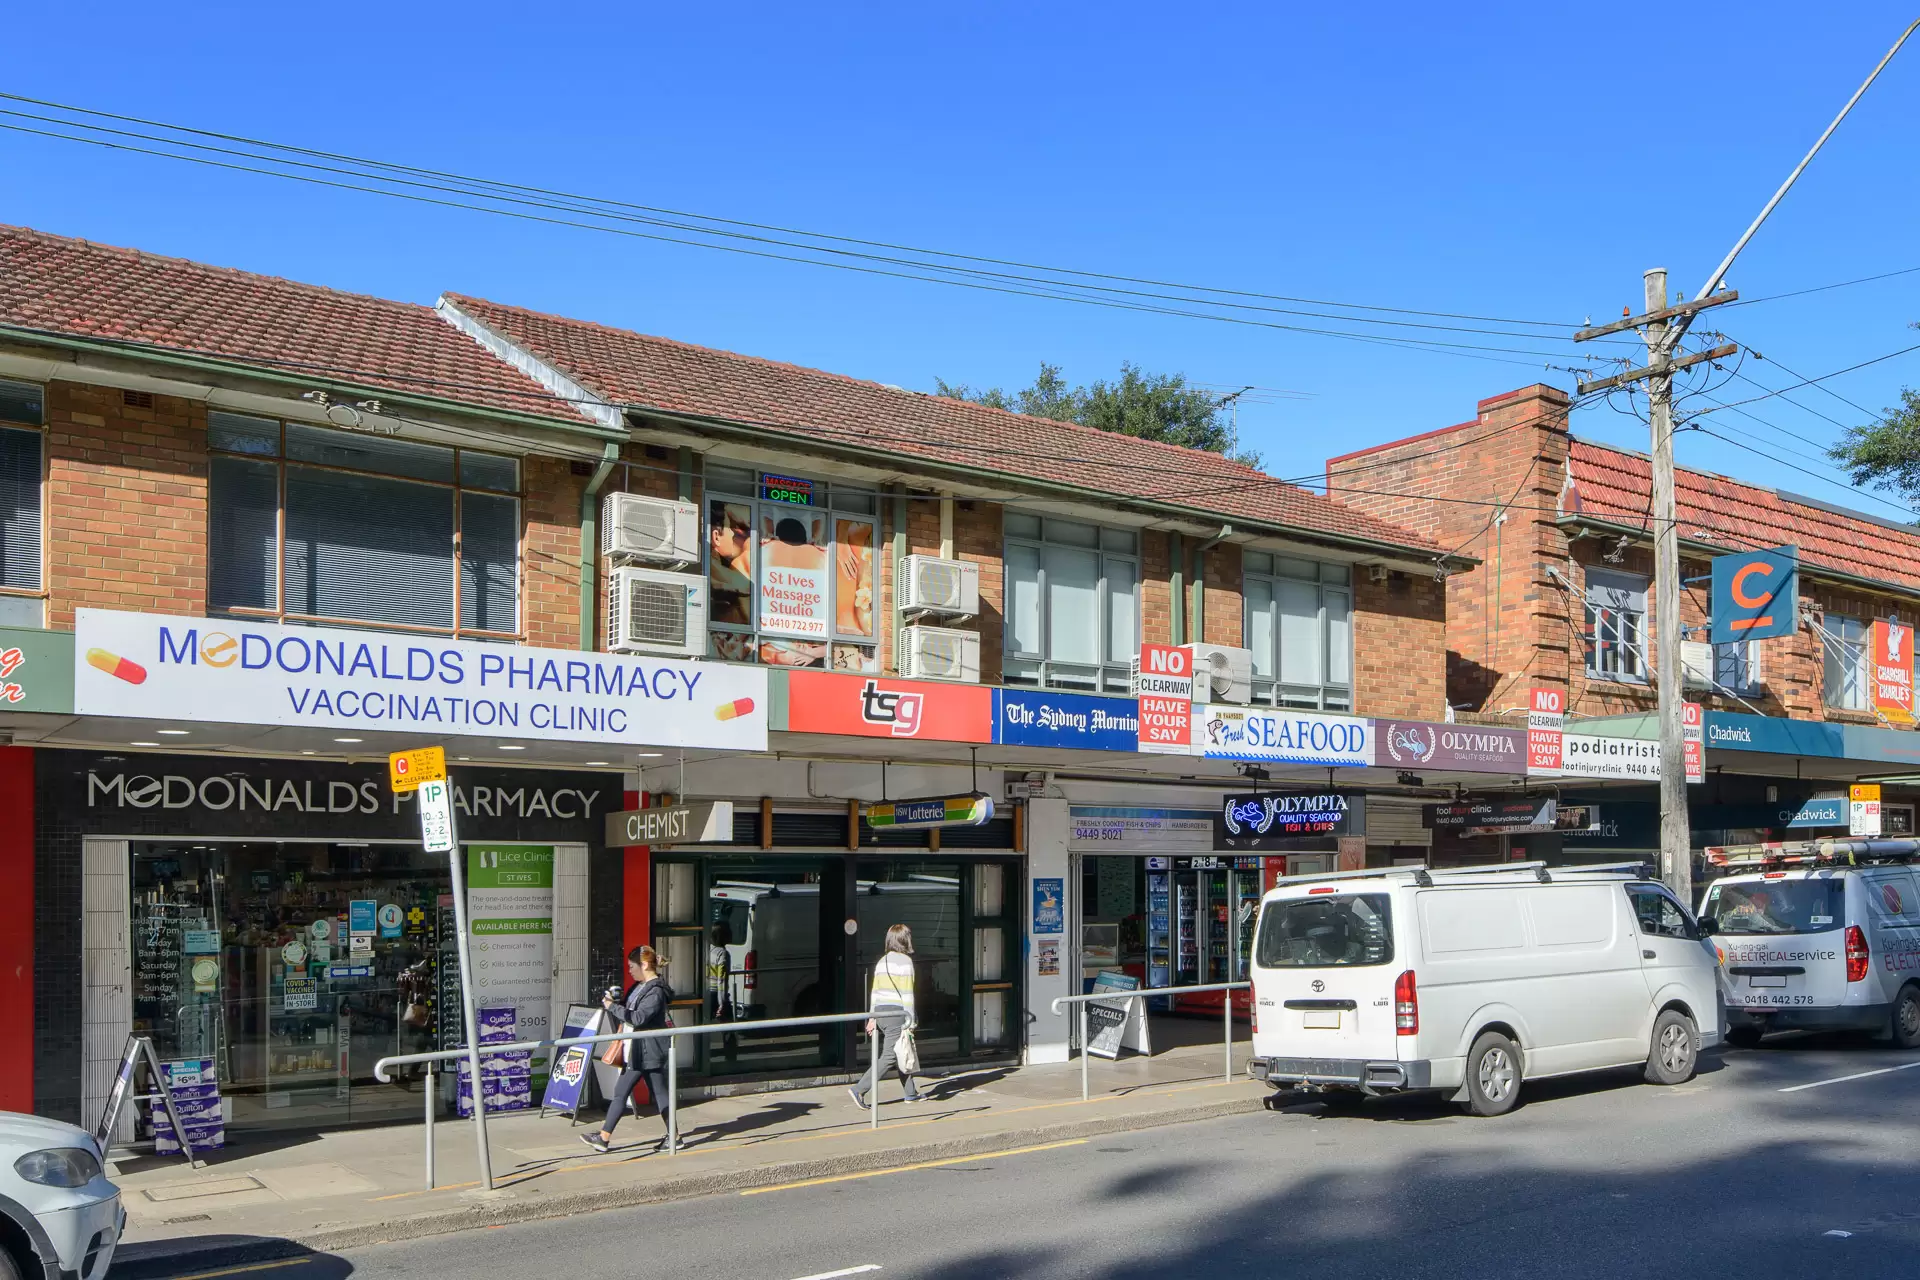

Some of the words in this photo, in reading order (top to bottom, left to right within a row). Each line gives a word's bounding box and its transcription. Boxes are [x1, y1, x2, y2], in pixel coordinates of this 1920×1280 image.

[770, 489, 807, 505] OPEN
[769, 571, 784, 584] St
[787, 573, 815, 588] Ives
[1732, 562, 1774, 609] C
[762, 585, 821, 605] Massage
[770, 601, 814, 617] Studio
[769, 617, 790, 629] 0410
[792, 620, 807, 631] 722
[808, 622, 824, 632] 977
[1150, 649, 1185, 674] NO
[480, 654, 702, 701] PHARMACY
[1878, 665, 1910, 684] CHARGRILL
[1141, 678, 1190, 695] CLEARWAY
[1879, 684, 1910, 702] CHARLIE'S
[1143, 698, 1187, 714] HAVE
[1536, 691, 1559, 710] NO
[287, 687, 518, 726] VACCINATION
[529, 703, 628, 733] CLINIC
[860, 679, 924, 736] tsg
[1006, 703, 1035, 728] The
[1036, 705, 1087, 732] Sydney
[1142, 713, 1187, 728] YOUR
[1529, 715, 1563, 728] CLEARWAY
[1149, 727, 1180, 741] SAY
[1221, 723, 1245, 747] Fresh
[1247, 717, 1365, 753] SEAFOOD
[1531, 731, 1560, 744] HAVE
[1709, 724, 1751, 742] Chadwick
[1441, 731, 1516, 753] OLYMPIA
[1530, 743, 1560, 755] YOUR
[1454, 752, 1477, 761] QUALITY
[1478, 753, 1504, 762] SEAFOOD
[1535, 754, 1556, 766] SAY
[397, 759, 407, 774] C
[1626, 763, 1647, 775] 9440
[404, 775, 433, 784] CLEARWAY
[425, 785, 442, 803] 1P
[1854, 788, 1860, 796] C
[393, 786, 600, 819] PARMACY
[1273, 795, 1349, 813] OLYMPIA
[895, 807, 908, 817] NSW
[908, 805, 944, 820] Lotteries
[1436, 804, 1492, 815] footinjuryclinic
[1778, 808, 1837, 821] Chadwick
[1076, 819, 1101, 827] FRESHLY
[1126, 820, 1140, 828] FISH
[1280, 813, 1307, 823] QUALITY
[1309, 813, 1341, 822] SEAFOOD
[627, 809, 690, 842] CHEMIST
[1285, 823, 1301, 832] FISH
[1304, 822, 1311, 831] &
[1313, 822, 1335, 831] CHIPS
[1076, 829, 1099, 840] 9449
[1101, 829, 1123, 840] 5021
[499, 851, 521, 862] Lice
[486, 895, 531, 903] one-and-done
[484, 903, 500, 911] head
[475, 922, 518, 931] AVAILABLE
[519, 922, 540, 930] HERE
[491, 942, 521, 950] Chemical
[140, 961, 177, 971] Saturday
[491, 960, 505, 968] Kills
[532, 959, 544, 967] nits
[144, 983, 174, 992] Sunday
[286, 979, 315, 987] COVID-19
[491, 978, 530, 986] Guaranteed
[286, 986, 315, 994] VACCINES
[510, 996, 518, 1004] by
[1744, 995, 1769, 1004] 0418
[1771, 995, 1791, 1004] 442
[1794, 995, 1814, 1004] 578
[489, 1016, 513, 1024] Quilton
[1091, 1007, 1123, 1021] SPECIALS
[520, 1016, 547, 1027] 5905
[565, 1059, 581, 1075] FREE
[504, 1084, 528, 1093] Quilton
[171, 1091, 200, 1100] Quilton
[175, 1103, 204, 1113] Quilton
